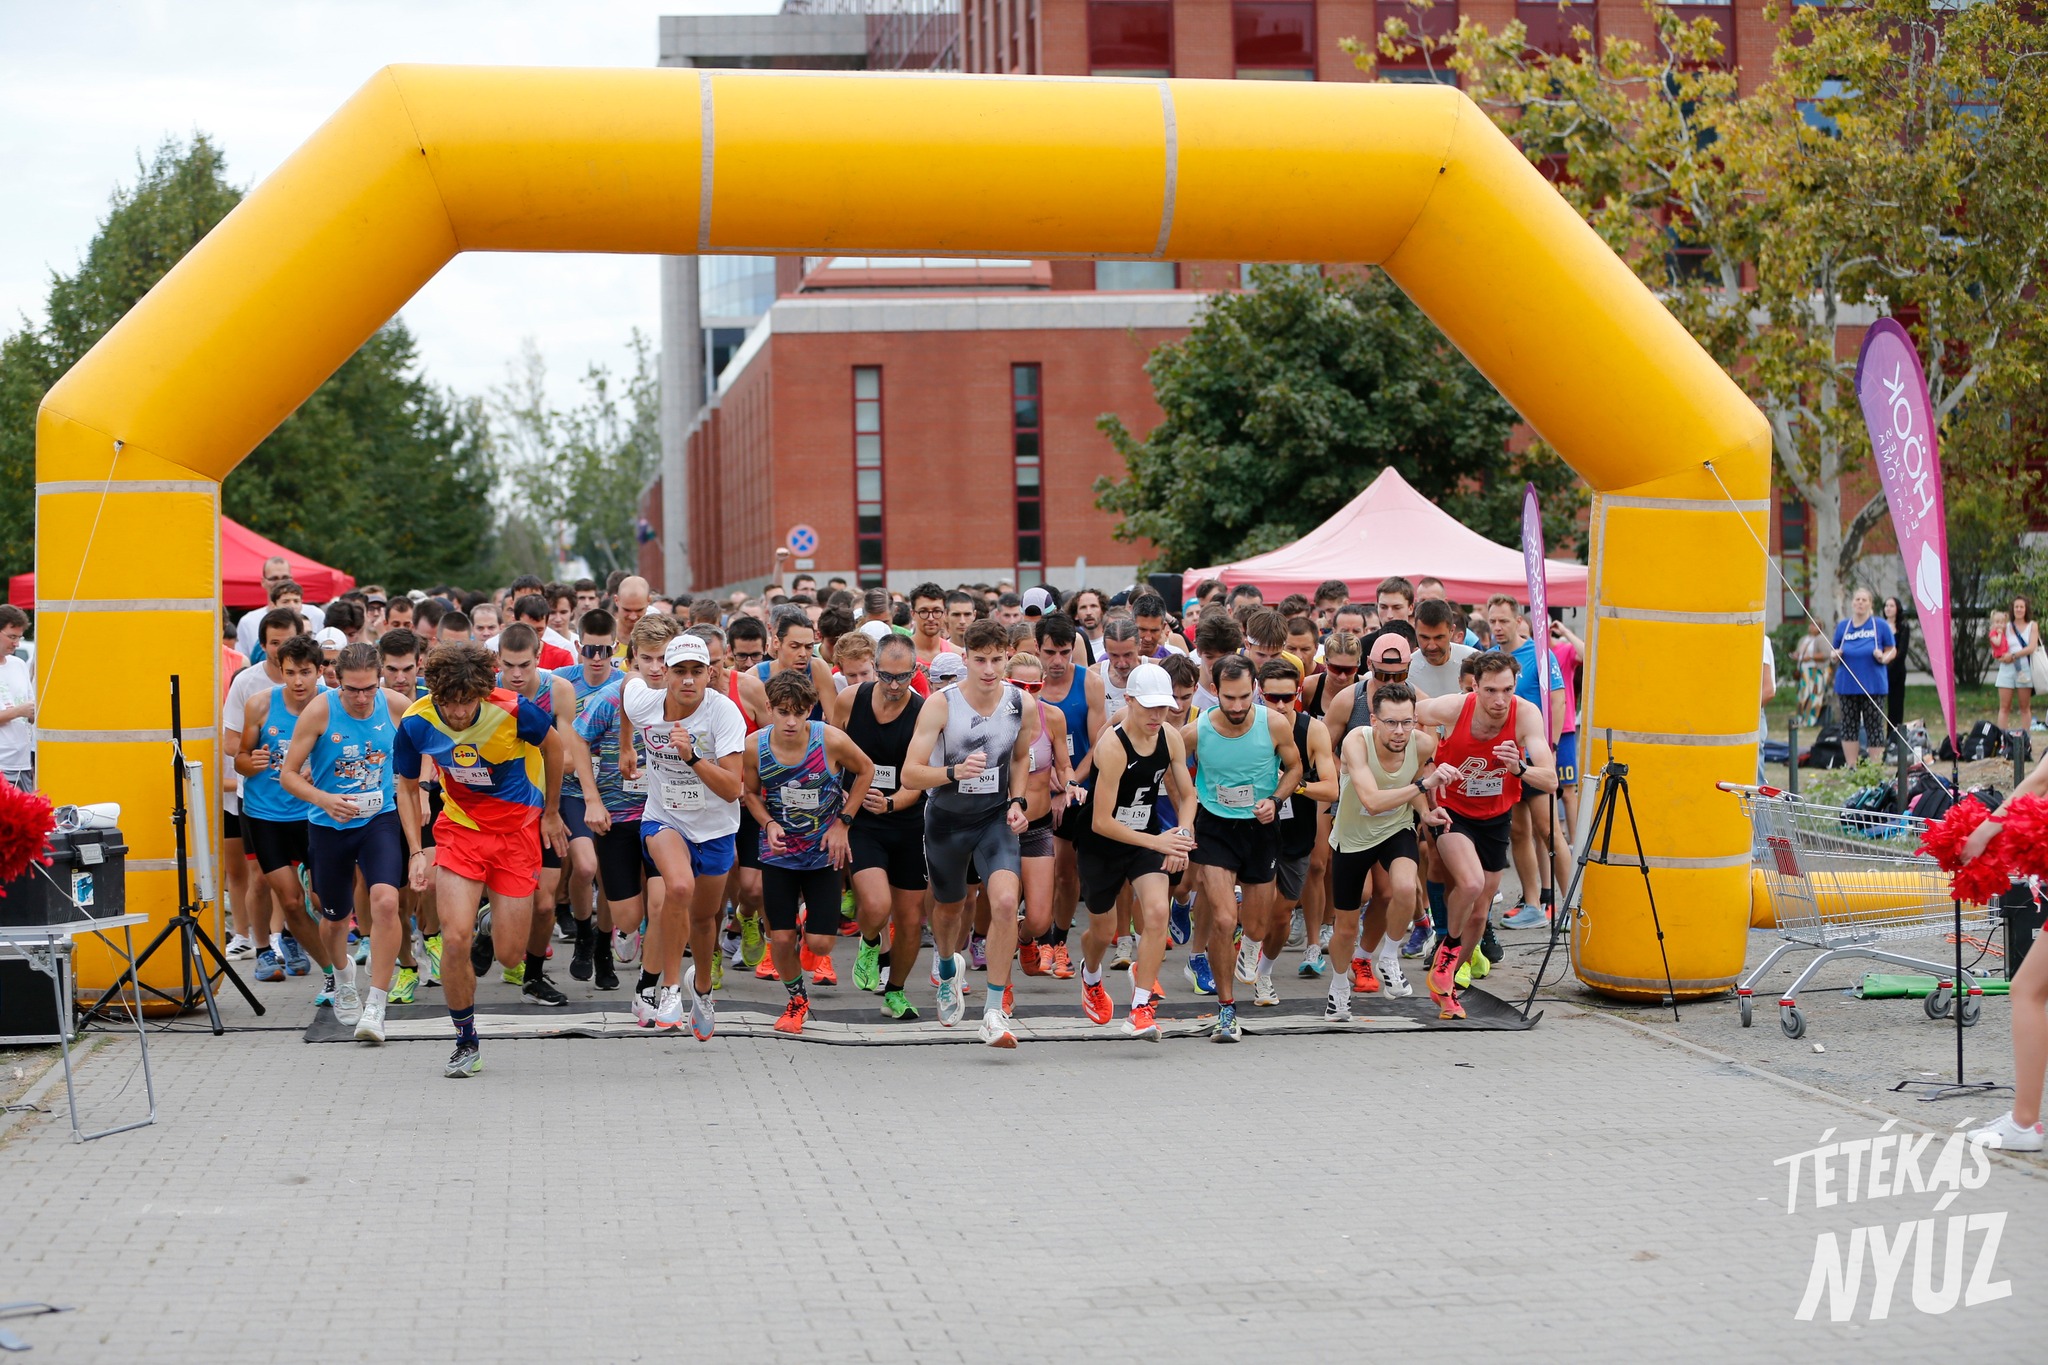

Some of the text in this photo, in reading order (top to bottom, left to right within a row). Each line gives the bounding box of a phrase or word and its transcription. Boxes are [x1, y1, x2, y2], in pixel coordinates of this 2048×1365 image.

[875, 769, 891, 778] 398
[1558, 766, 1575, 780] 10
[979, 774, 995, 783] 894
[680, 790, 699, 799] 728
[1238, 789, 1249, 797] 77
[367, 797, 382, 807] 173
[1131, 811, 1146, 819] 136
